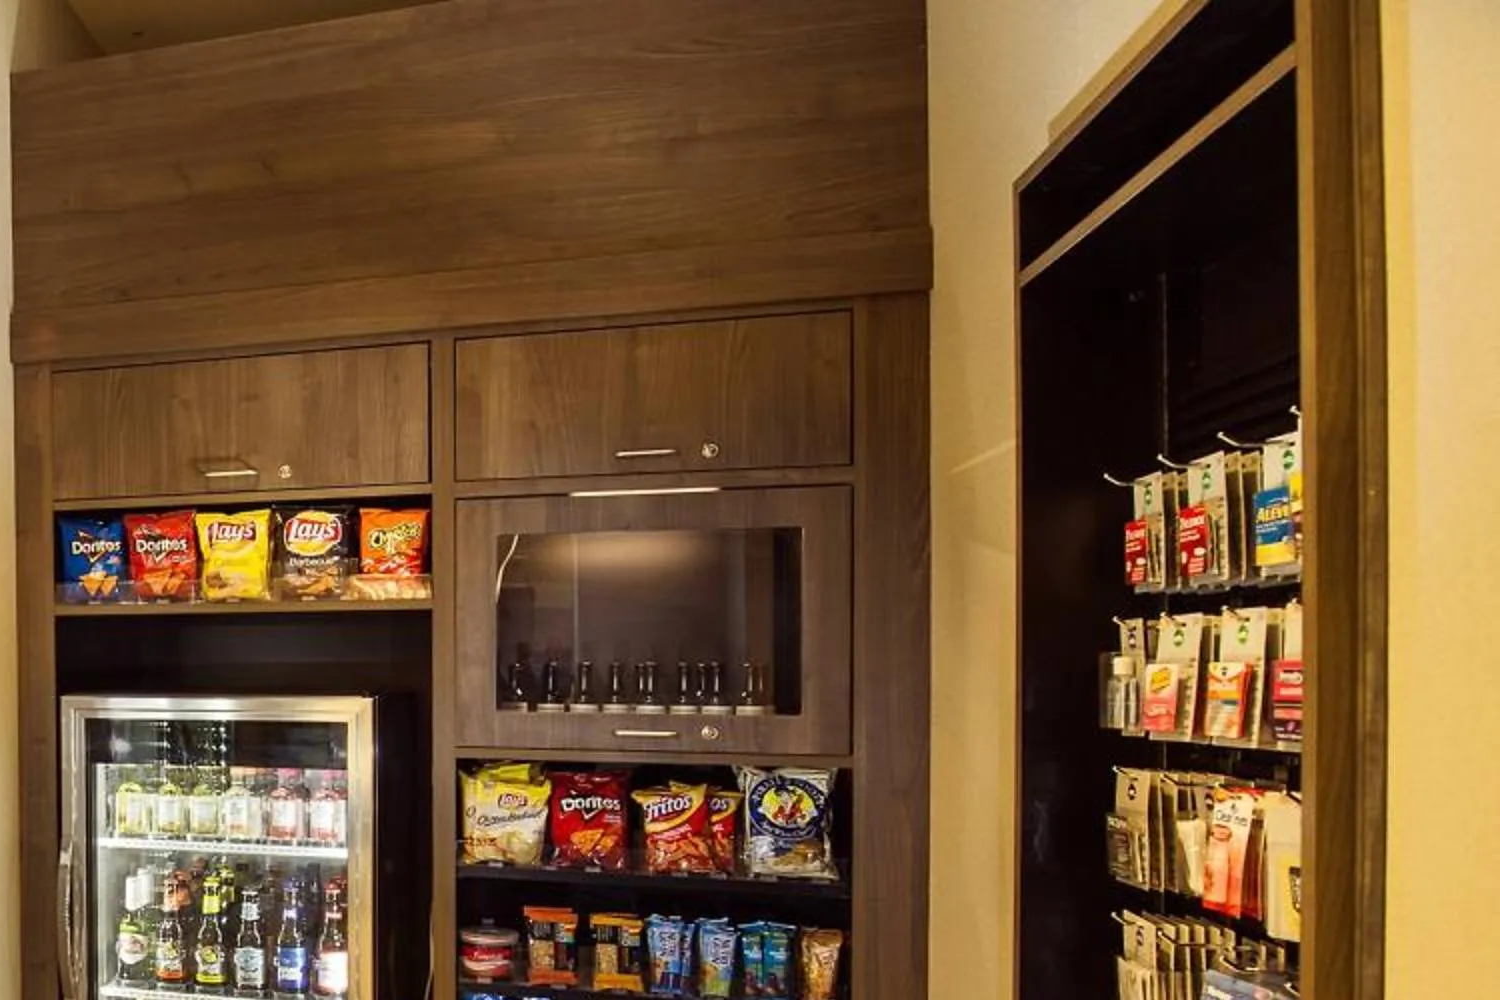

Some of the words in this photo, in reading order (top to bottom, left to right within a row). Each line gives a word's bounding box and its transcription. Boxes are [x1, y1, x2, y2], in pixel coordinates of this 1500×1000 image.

[71, 540, 121, 555] Doritos
[135, 538, 187, 553] Doritos
[561, 797, 621, 812] Doritos
